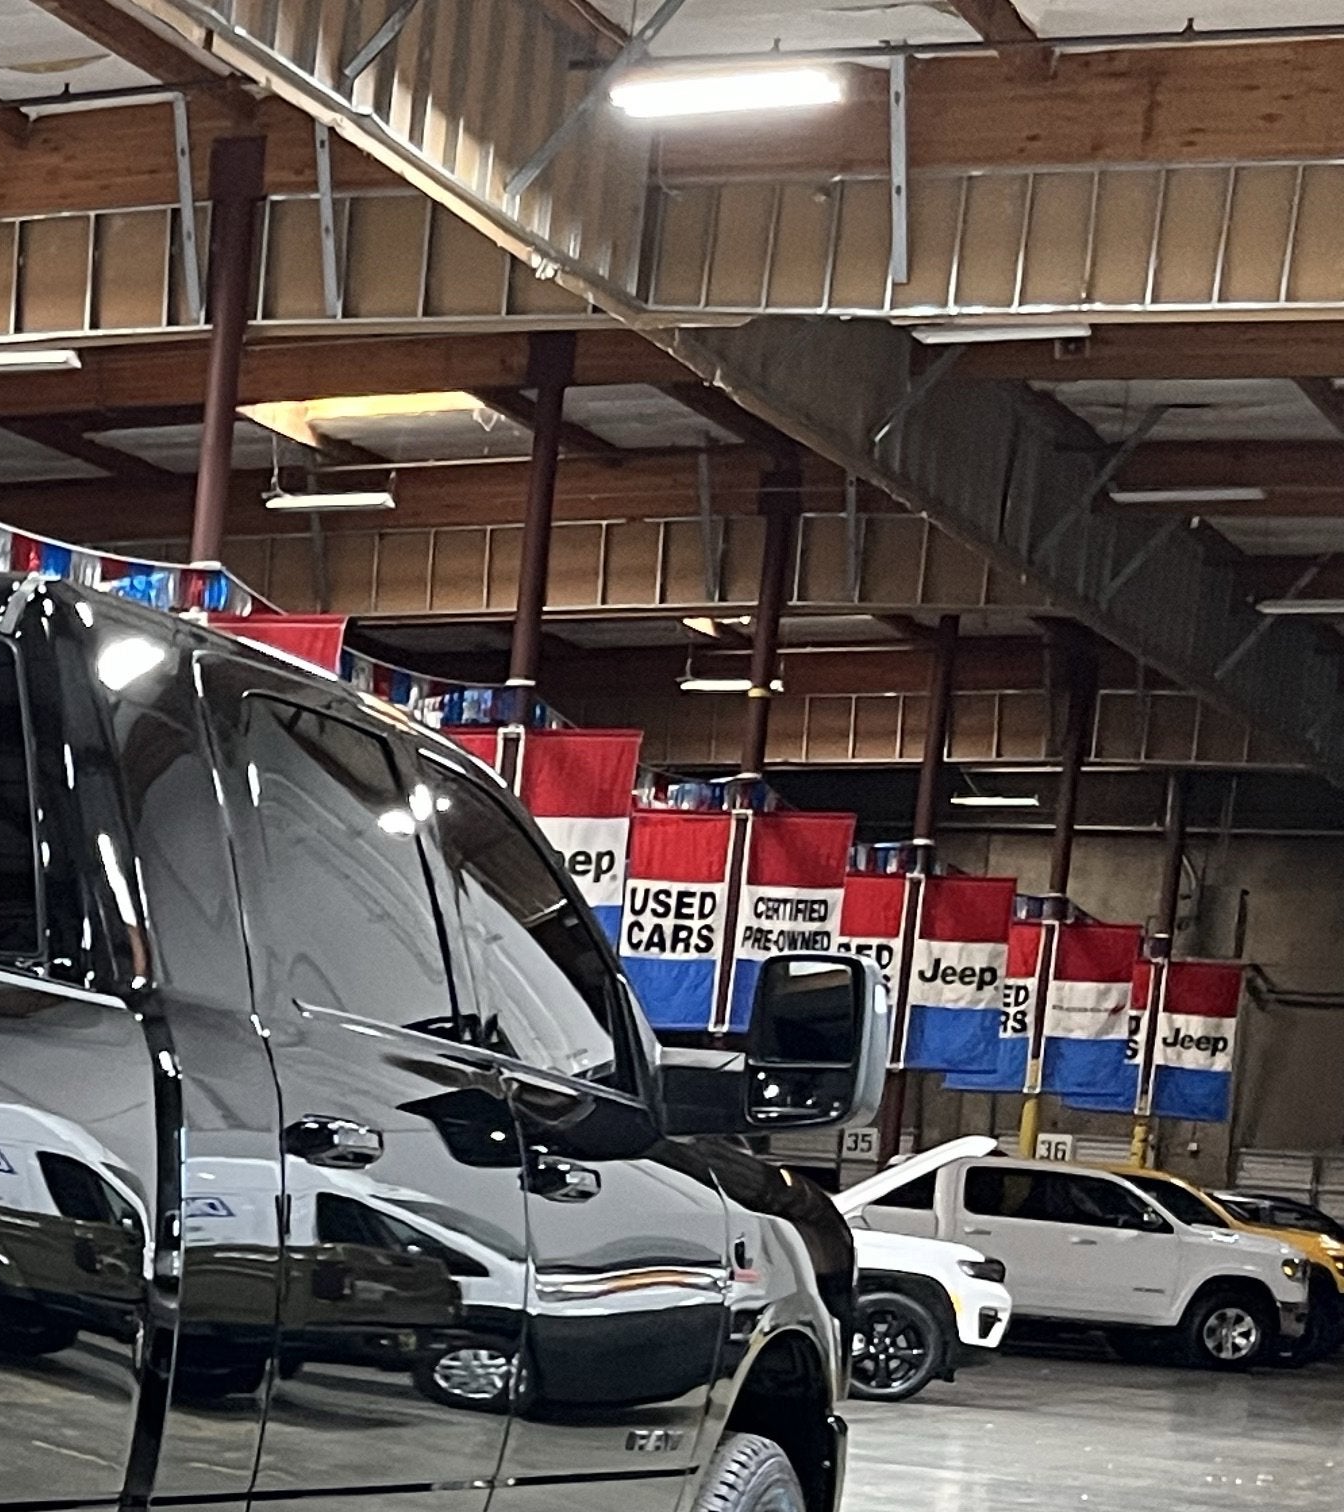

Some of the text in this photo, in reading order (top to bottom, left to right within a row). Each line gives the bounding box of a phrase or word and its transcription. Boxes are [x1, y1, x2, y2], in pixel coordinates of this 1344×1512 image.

[553, 849, 616, 883] ep
[629, 886, 718, 920] USED
[753, 896, 829, 923] CERTIFIED
[626, 920, 714, 954] CARS
[740, 925, 832, 952] PRE-OWNED
[917, 957, 999, 991] Jeep
[1161, 1027, 1229, 1057] Jeep
[846, 1132, 873, 1153] 35
